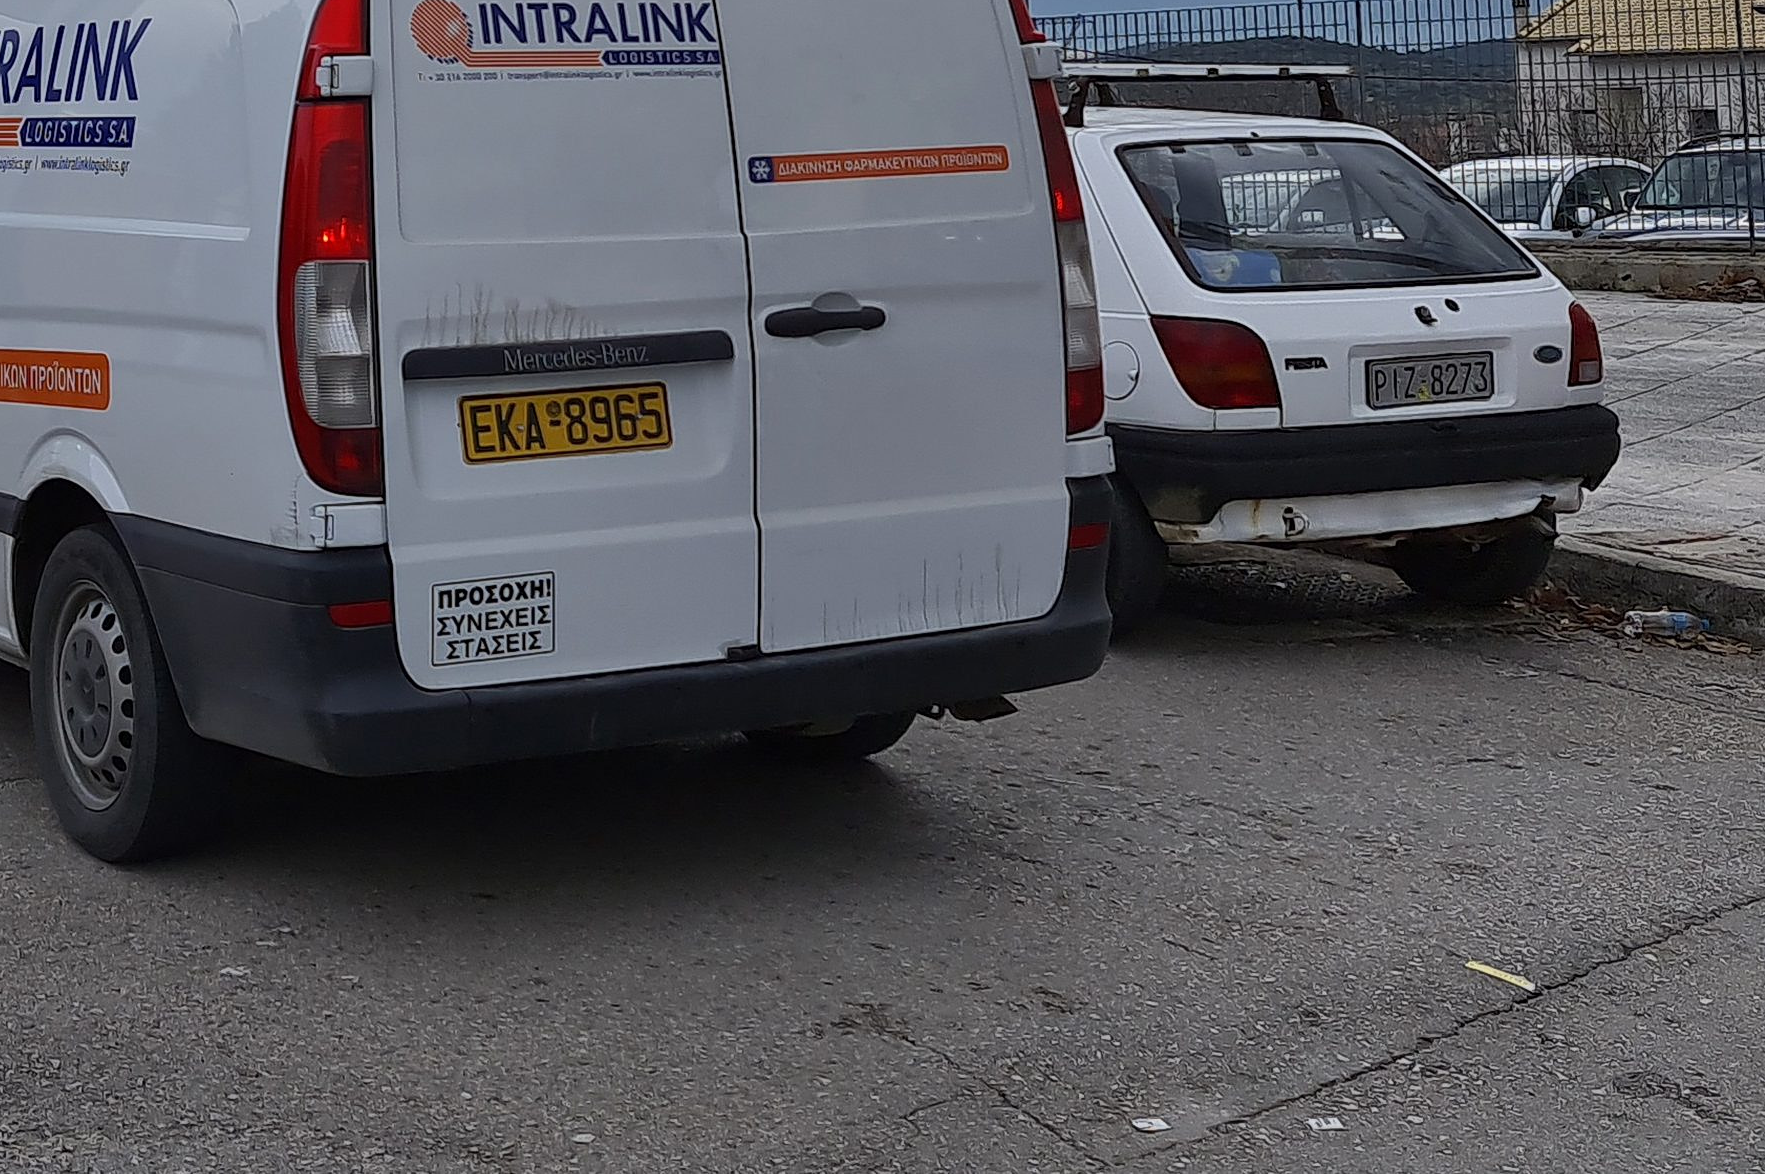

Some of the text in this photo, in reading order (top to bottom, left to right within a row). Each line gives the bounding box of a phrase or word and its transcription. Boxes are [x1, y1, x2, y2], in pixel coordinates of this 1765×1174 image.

[478, 2, 716, 44] INTRALINK
[608, 51, 692, 64] LOGISTICS
[24, 120, 103, 144] LOGISTICS
[778, 161, 842, 176] ΔΙΑΚΙΝΗΣΗ
[844, 157, 939, 173] ΦΑΡΜΑΚΕΥΤΙΚΩΝ
[502, 343, 649, 372] Mercedes-Benz
[437, 579, 552, 610] ΠΡΟΣΟΧΗ!
[437, 605, 551, 637] ΣΥΝΕΧΕΙΣ
[446, 630, 542, 660] ΣΤΑΣΕΙΣ
